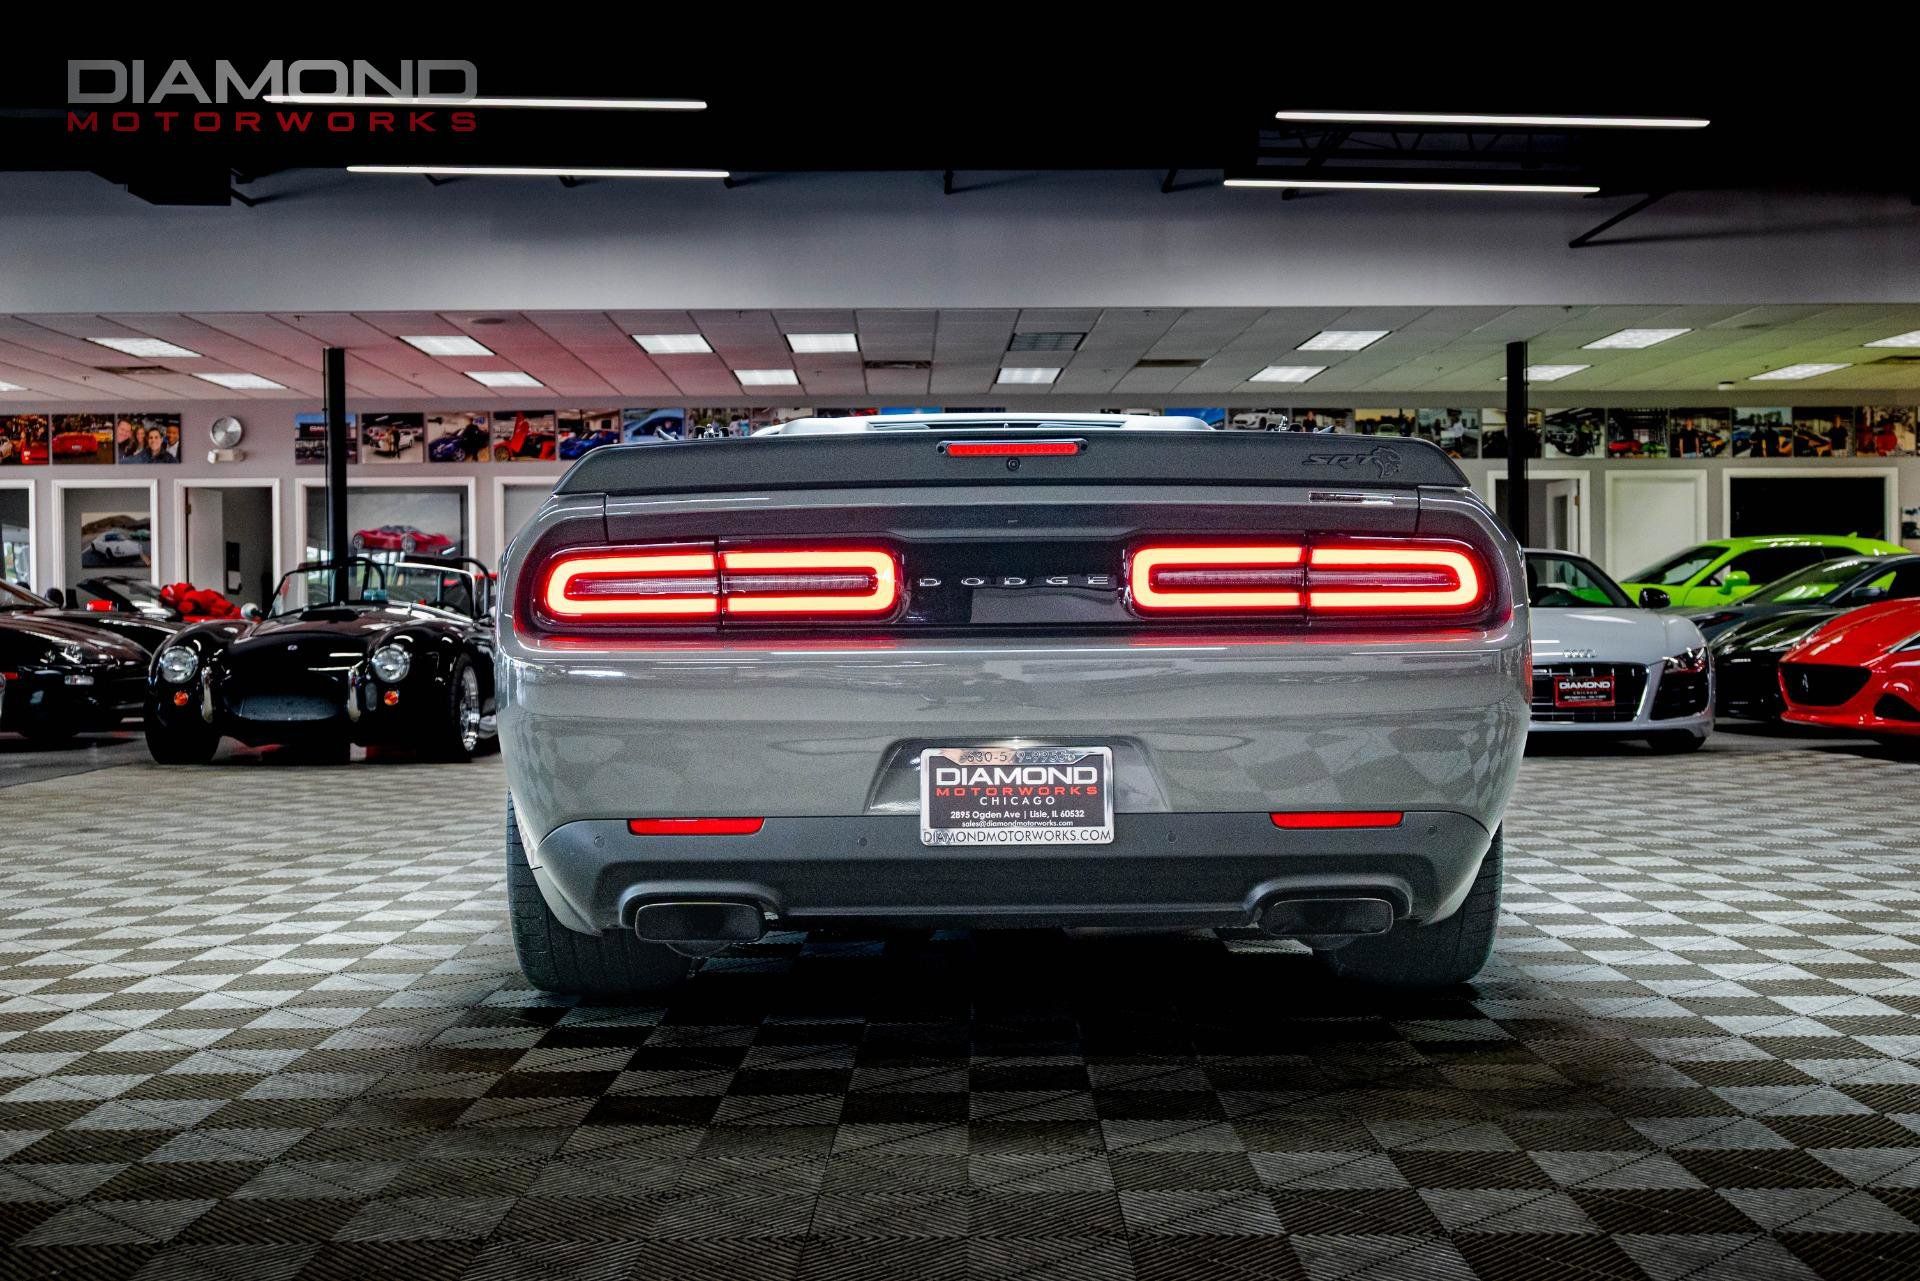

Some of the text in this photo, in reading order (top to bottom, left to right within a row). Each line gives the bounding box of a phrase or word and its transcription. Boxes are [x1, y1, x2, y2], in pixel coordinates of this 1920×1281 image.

[919, 576, 1108, 587] DODGE
[936, 767, 1097, 785] DIAMOND
[936, 786, 1097, 796] MOTORWORKS
[979, 797, 1056, 805] CHICAGO
[950, 811, 970, 819] 2895
[972, 811, 1001, 820] Ogden
[1003, 811, 1020, 819] Ave
[1029, 810, 1050, 819] Lisle,
[1051, 810, 1059, 818] IL
[1060, 809, 1085, 818] 60532
[961, 820, 1074, 828] sales@diamondmotorworks.com
[924, 830, 1111, 842] DIAMONDMOTORWORKS.COM
